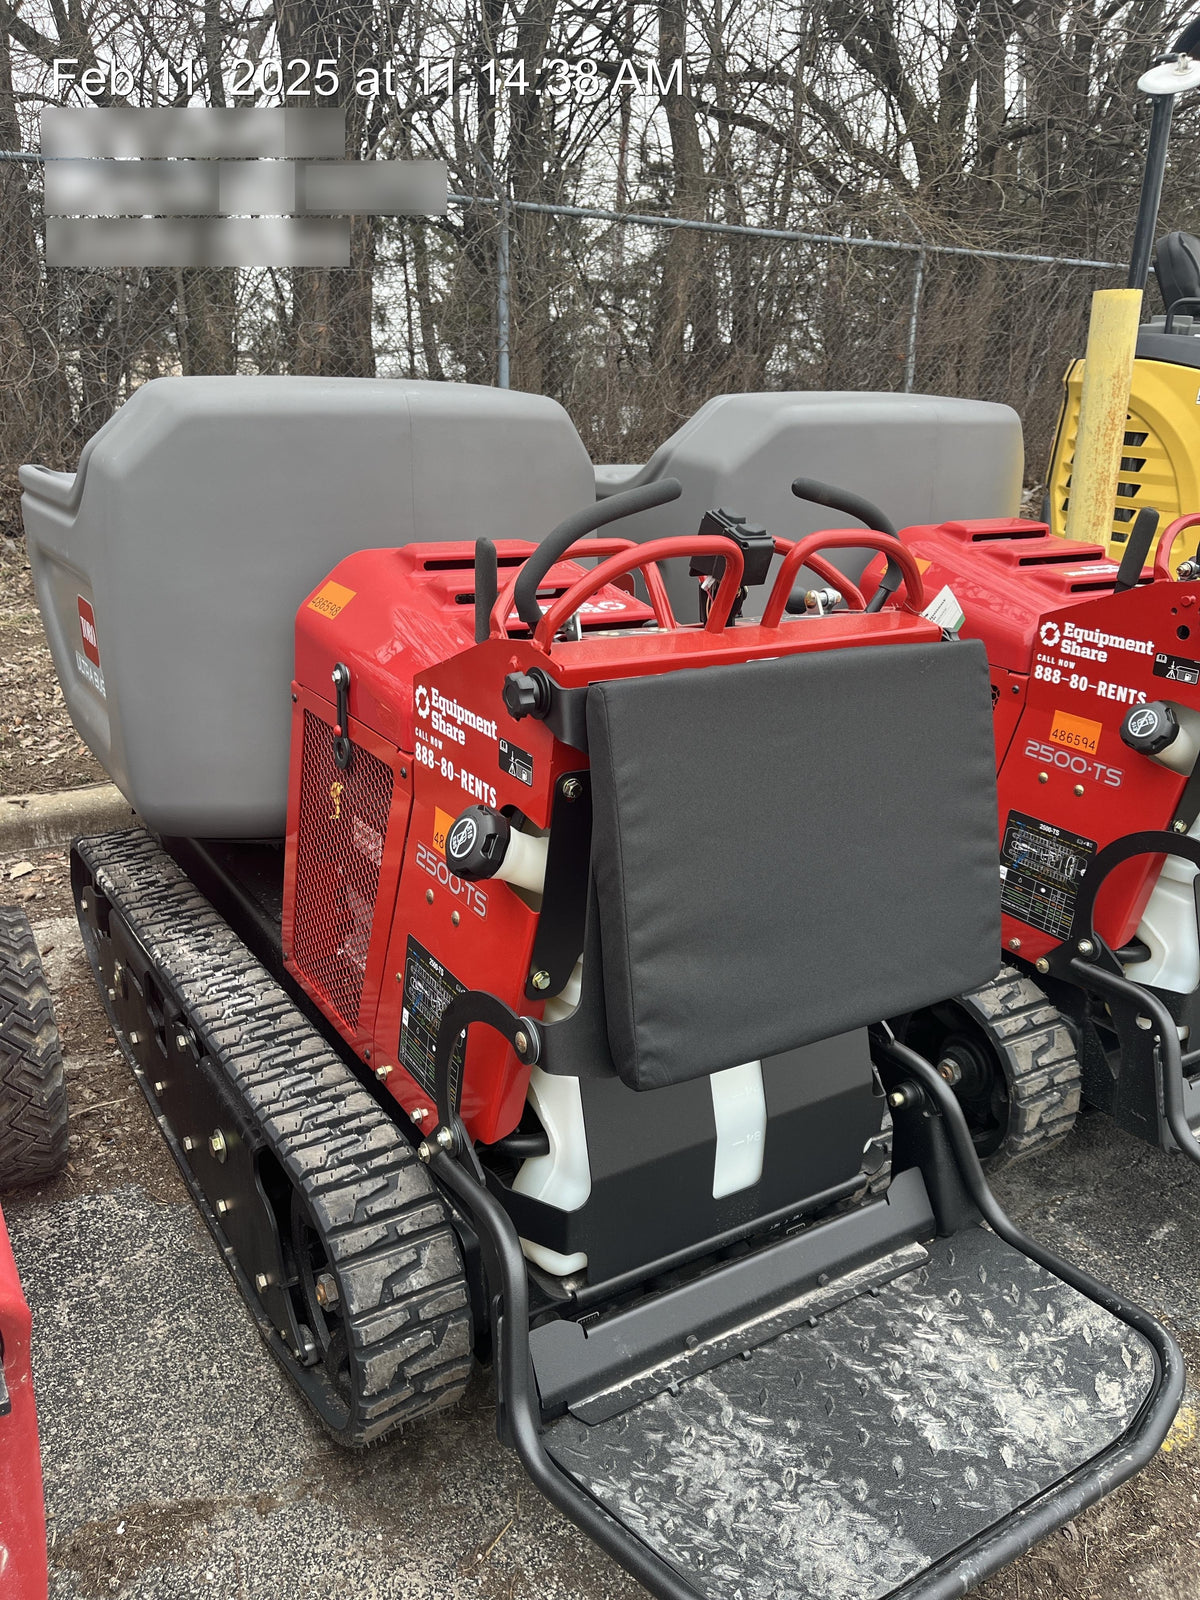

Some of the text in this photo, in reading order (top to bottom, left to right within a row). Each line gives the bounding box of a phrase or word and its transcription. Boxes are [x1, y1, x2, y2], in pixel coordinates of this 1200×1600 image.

[1060, 639, 1108, 663] Share
[1063, 622, 1155, 656] Equipment
[1036, 653, 1076, 670] CALL NOW
[1034, 664, 1148, 705] 888-80-RENTS
[430, 686, 498, 741] Equipment
[431, 713, 466, 746] Share
[415, 727, 443, 750] CALL NOW
[1051, 728, 1096, 751] 486594
[415, 742, 497, 808] 888-80-RENTS
